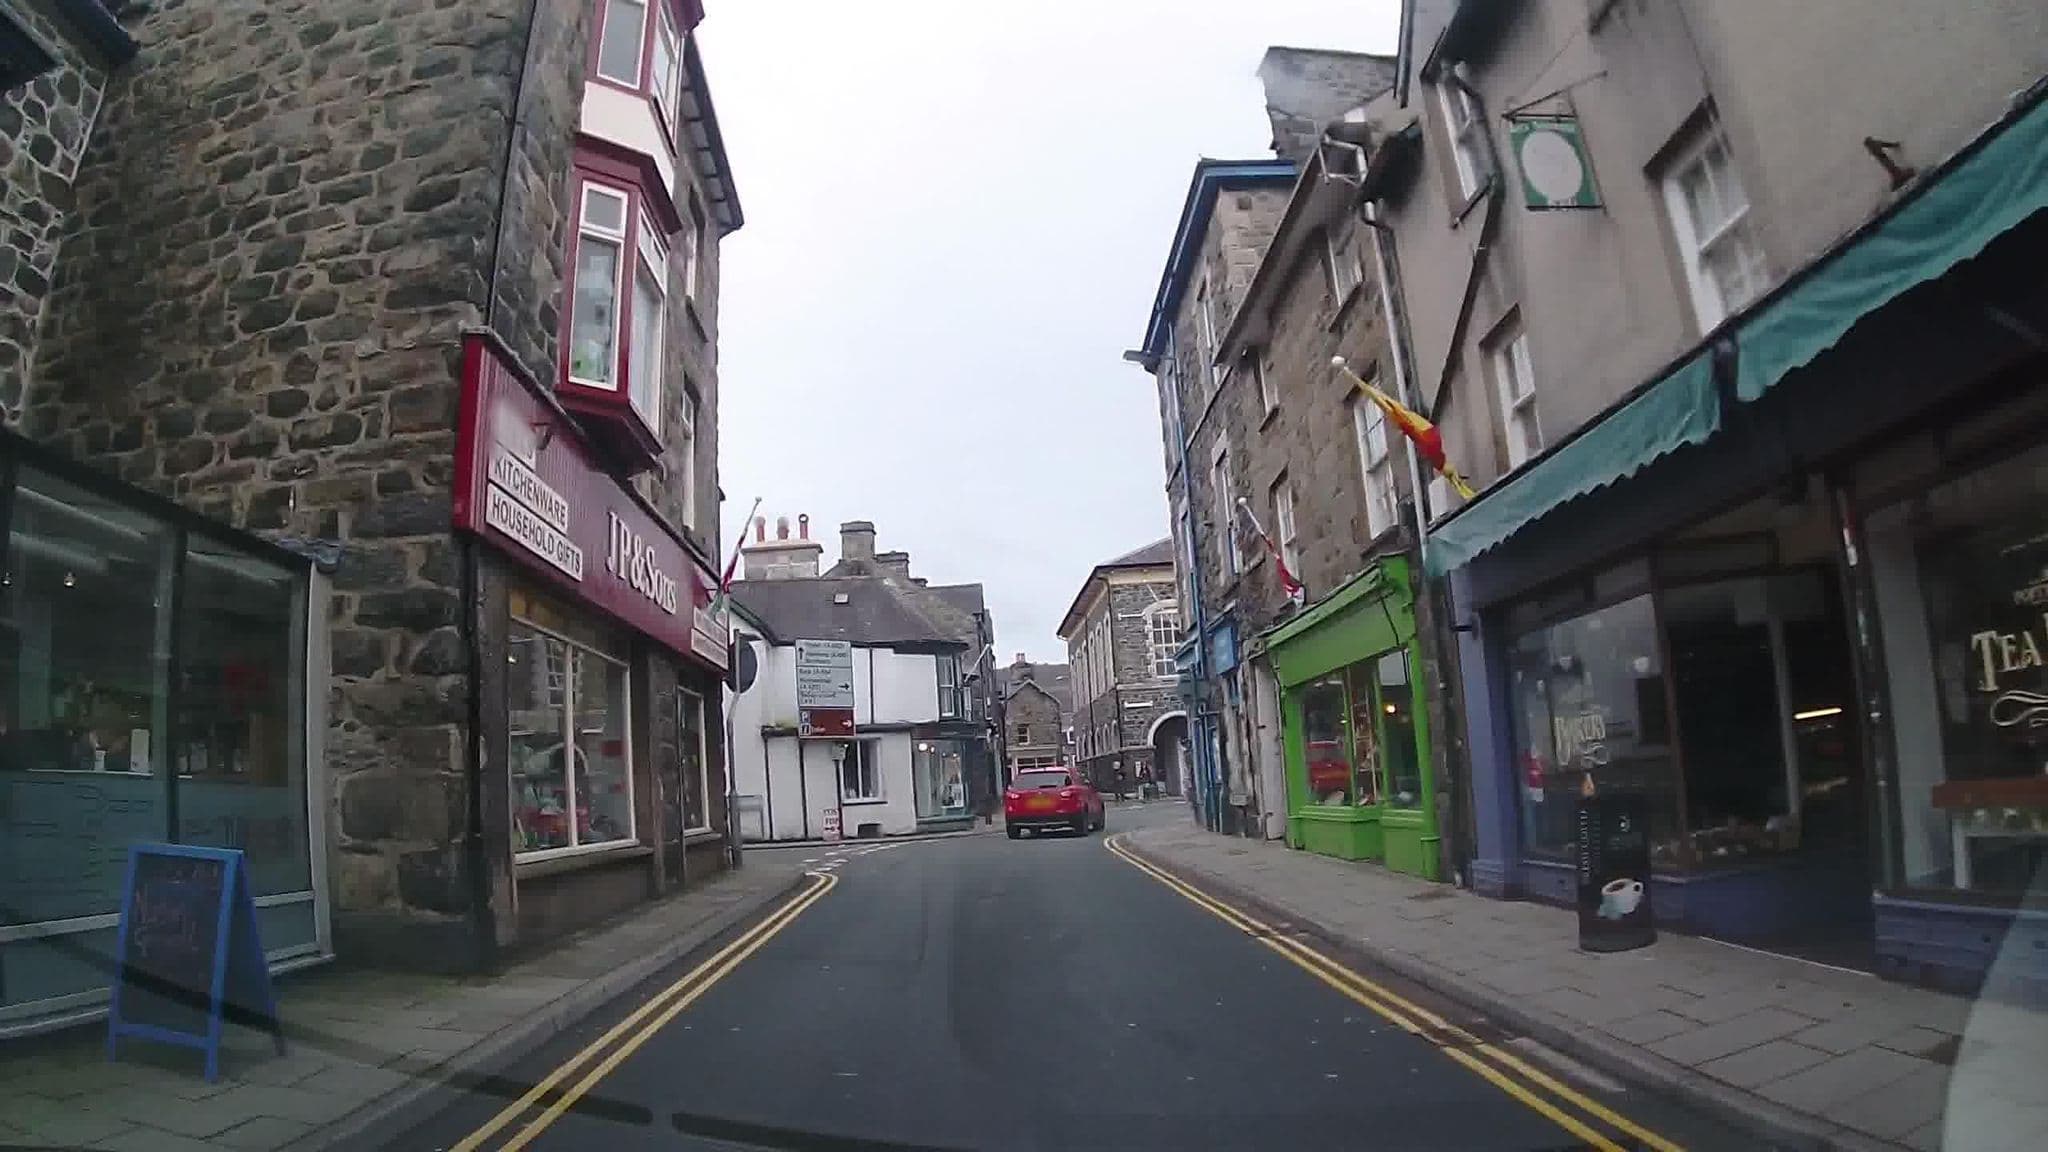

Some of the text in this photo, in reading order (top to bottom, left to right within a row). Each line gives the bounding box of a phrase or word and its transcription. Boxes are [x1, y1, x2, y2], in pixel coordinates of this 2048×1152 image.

[494, 455, 566, 527] KITCHENWARE
[492, 493, 581, 574] HOUSEHOLD GIFTS
